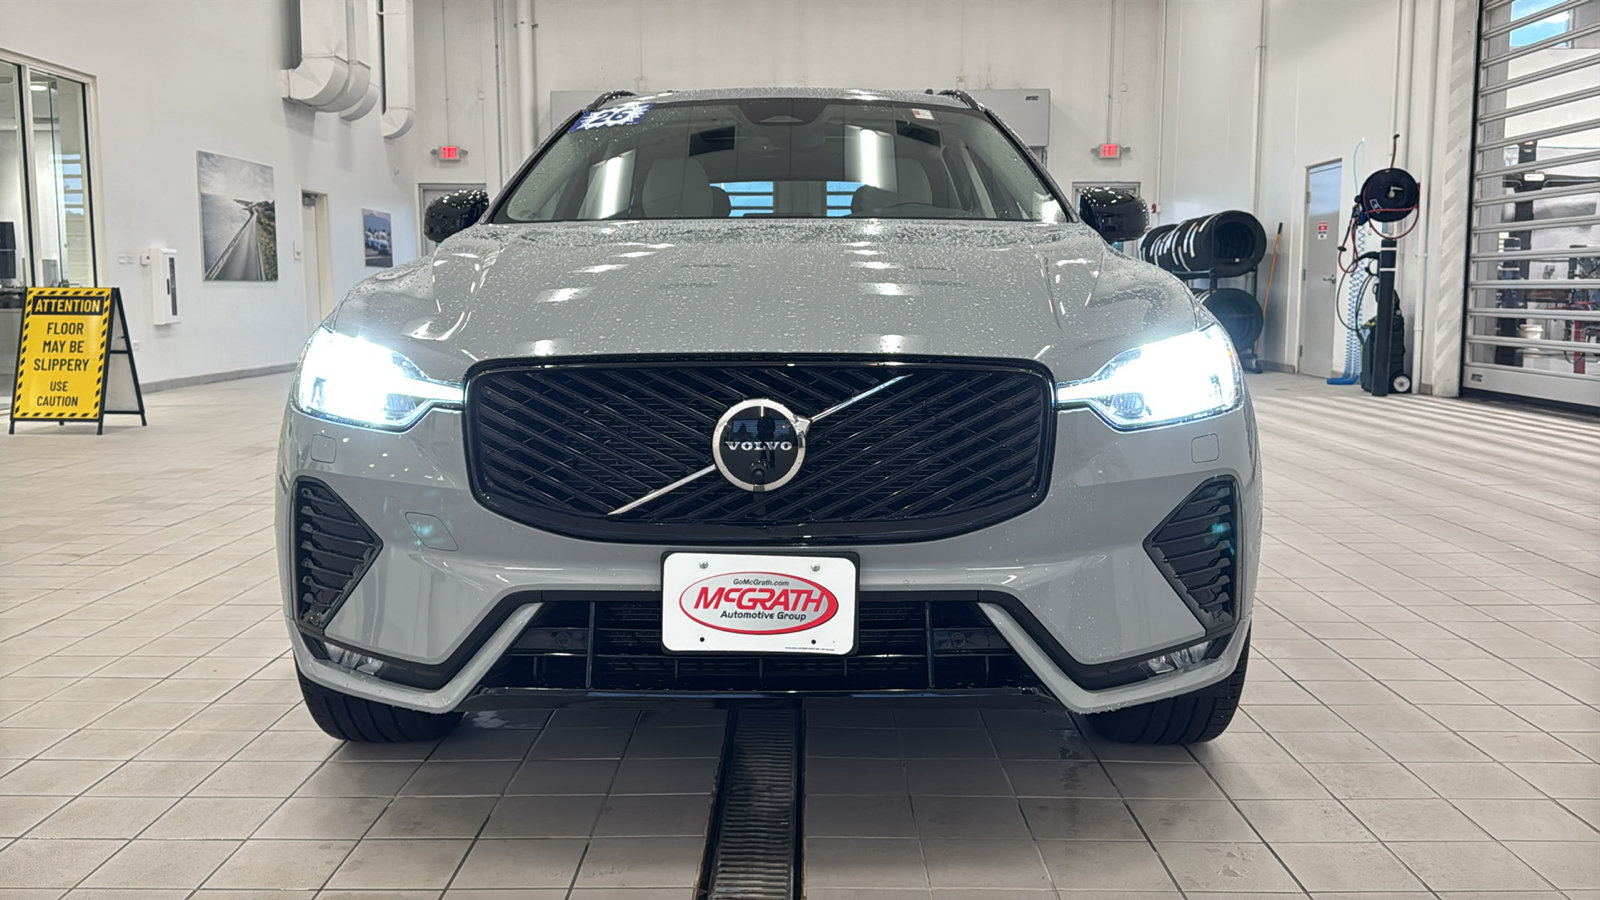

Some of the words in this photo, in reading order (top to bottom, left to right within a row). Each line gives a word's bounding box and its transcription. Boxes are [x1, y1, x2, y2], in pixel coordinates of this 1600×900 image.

[441, 146, 457, 159] EXIT
[1102, 144, 1118, 158] EXIT
[34, 298, 101, 313] ATTENTION
[46, 322, 85, 336] FLOOR
[42, 340, 67, 353] MAY
[69, 340, 85, 353] BE
[33, 358, 90, 372] SLIPPERY
[49, 381, 69, 392] USE
[36, 396, 79, 407] CAUTION
[725, 441, 793, 451] VOLVO
[732, 578, 790, 587] GoMcGrath.com
[720, 610, 775, 620] Automotive
[777, 611, 807, 622] Group
